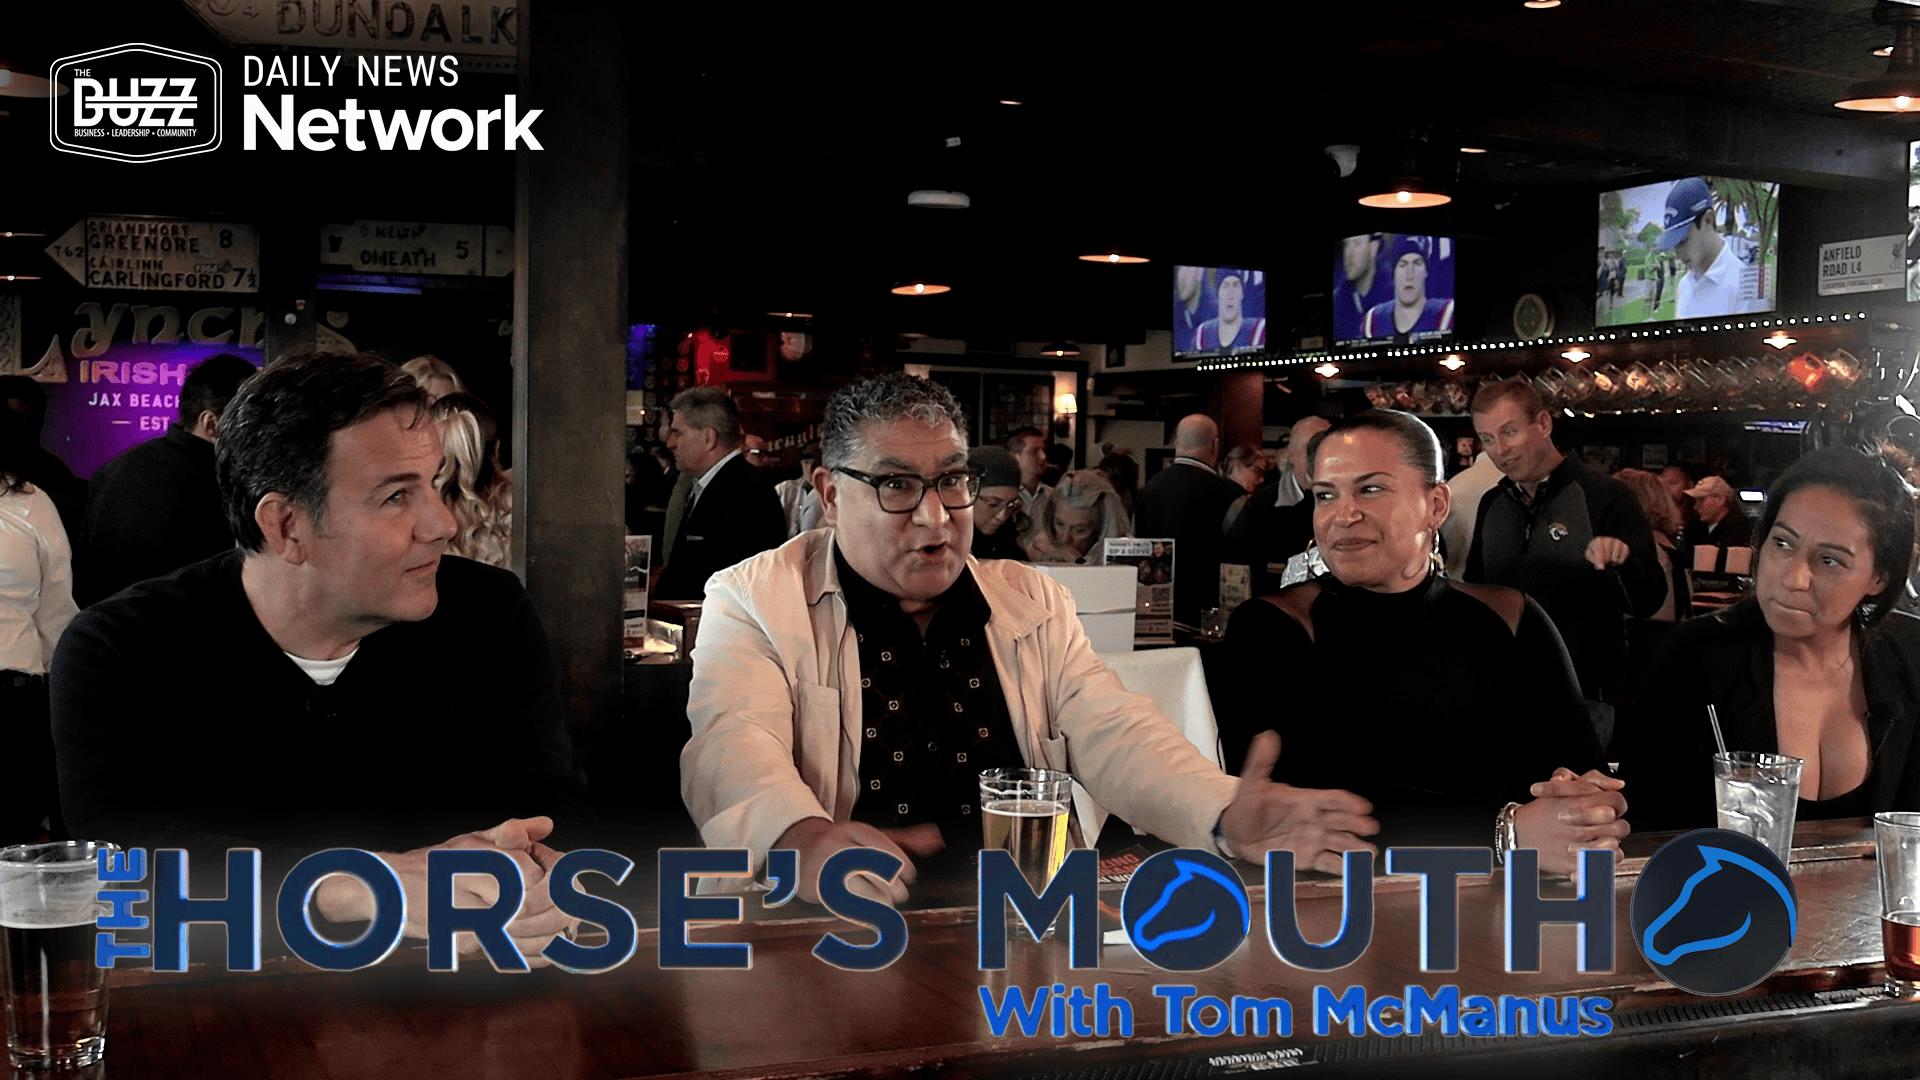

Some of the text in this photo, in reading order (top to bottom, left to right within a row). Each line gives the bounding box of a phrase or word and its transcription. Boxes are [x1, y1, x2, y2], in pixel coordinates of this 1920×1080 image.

[277, 0, 517, 45] DUNDALK
[88, 229, 233, 253] GREENORE 8
[456, 240, 469, 259] 5
[1823, 245, 1862, 262] ANFIELD
[1823, 261, 1862, 277] ROAD L4
[88, 270, 226, 289] CARLINGFORD
[80, 360, 187, 385] IRISH
[88, 392, 122, 407] JAX
